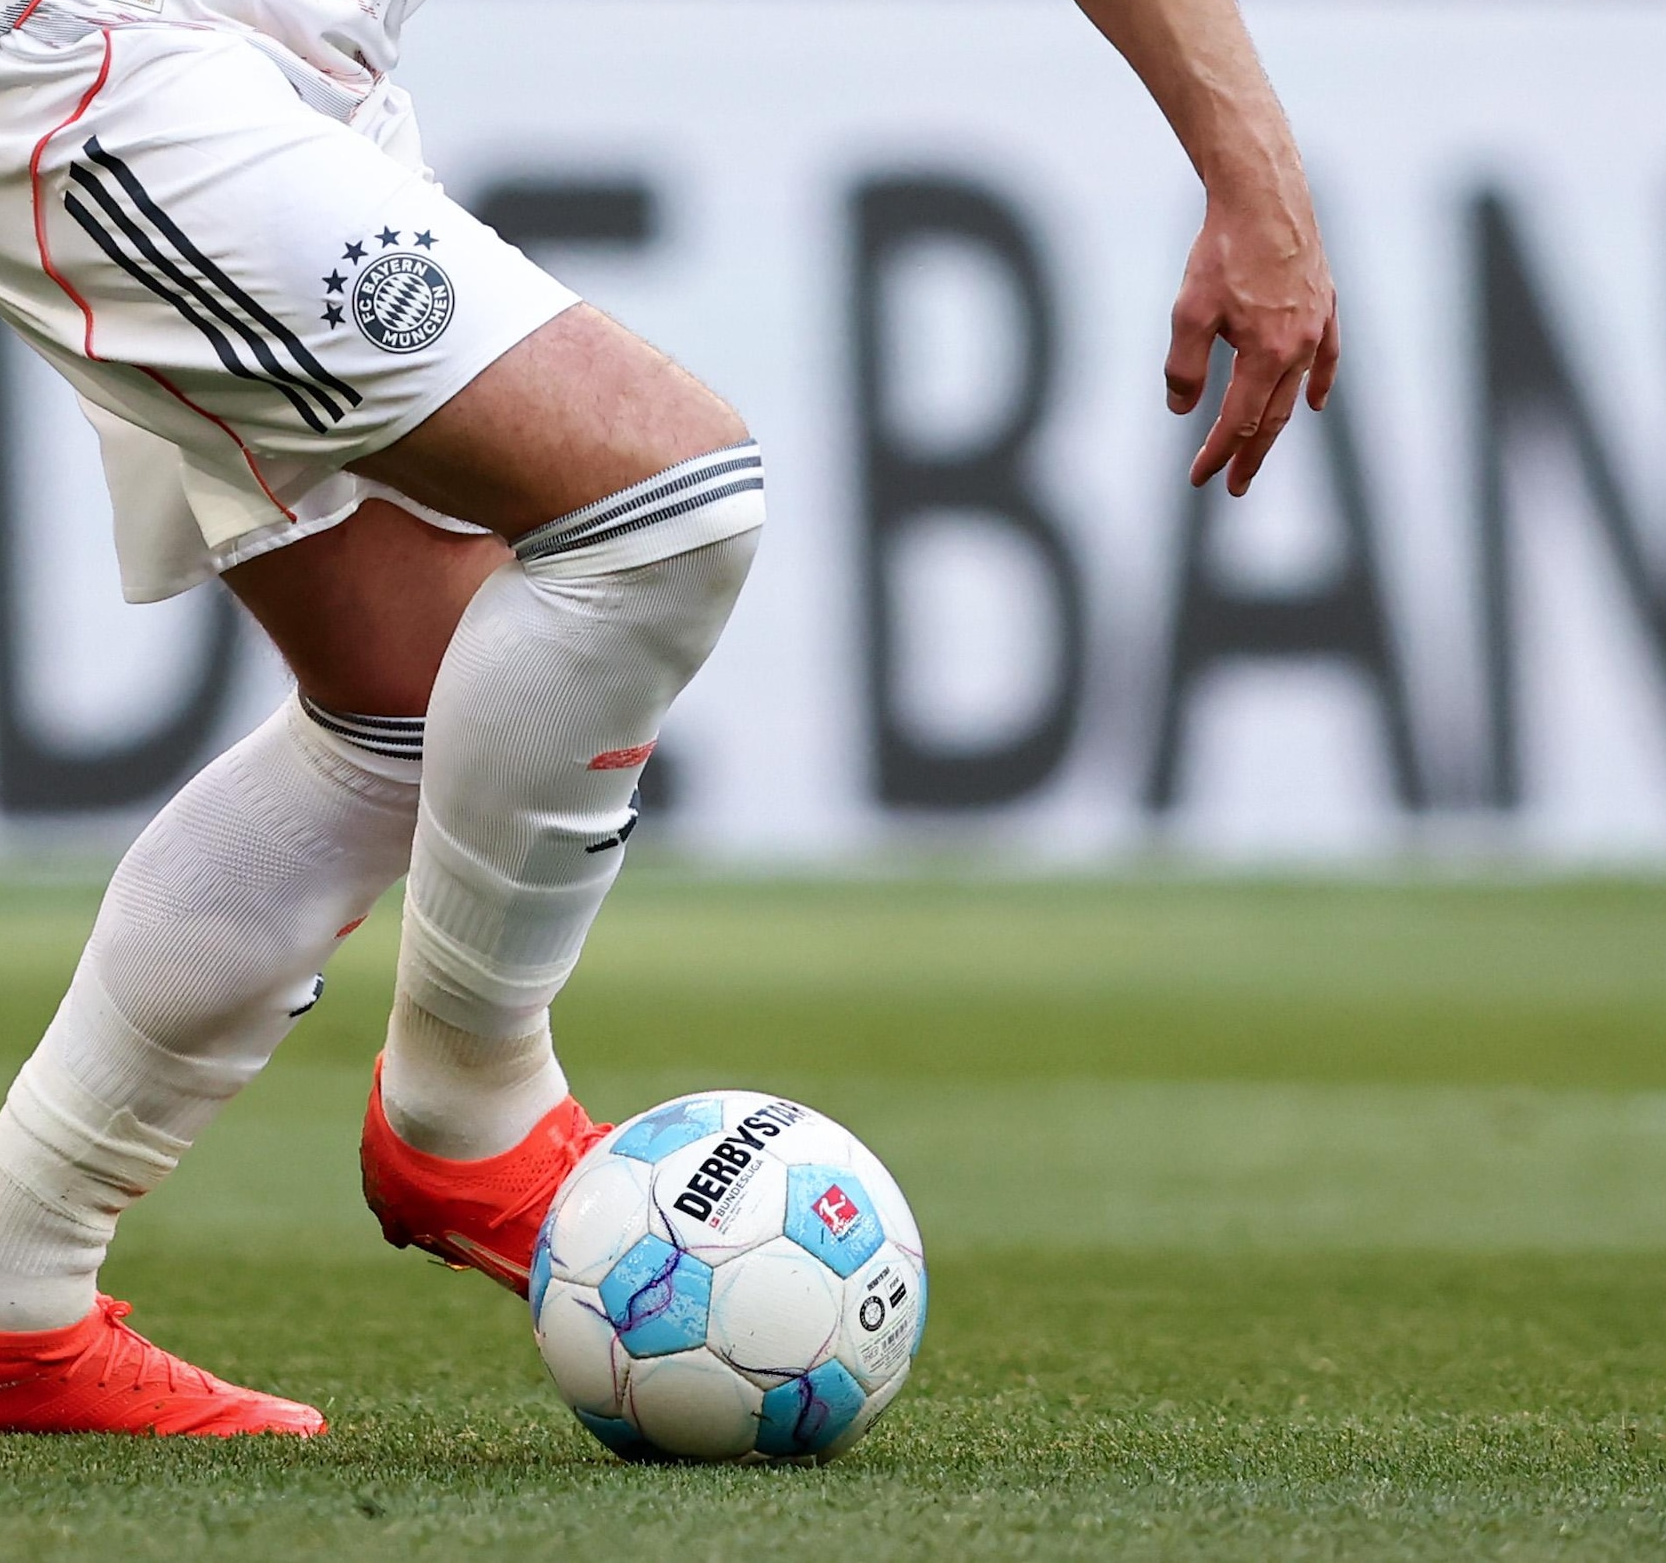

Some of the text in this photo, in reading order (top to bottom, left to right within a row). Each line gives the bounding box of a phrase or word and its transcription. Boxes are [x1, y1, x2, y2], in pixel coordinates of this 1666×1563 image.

[359, 258, 428, 323] FC BAYERN
[382, 284, 447, 347] MÜNCHEN
[716, 1159, 763, 1217] BUNDESLIGA
